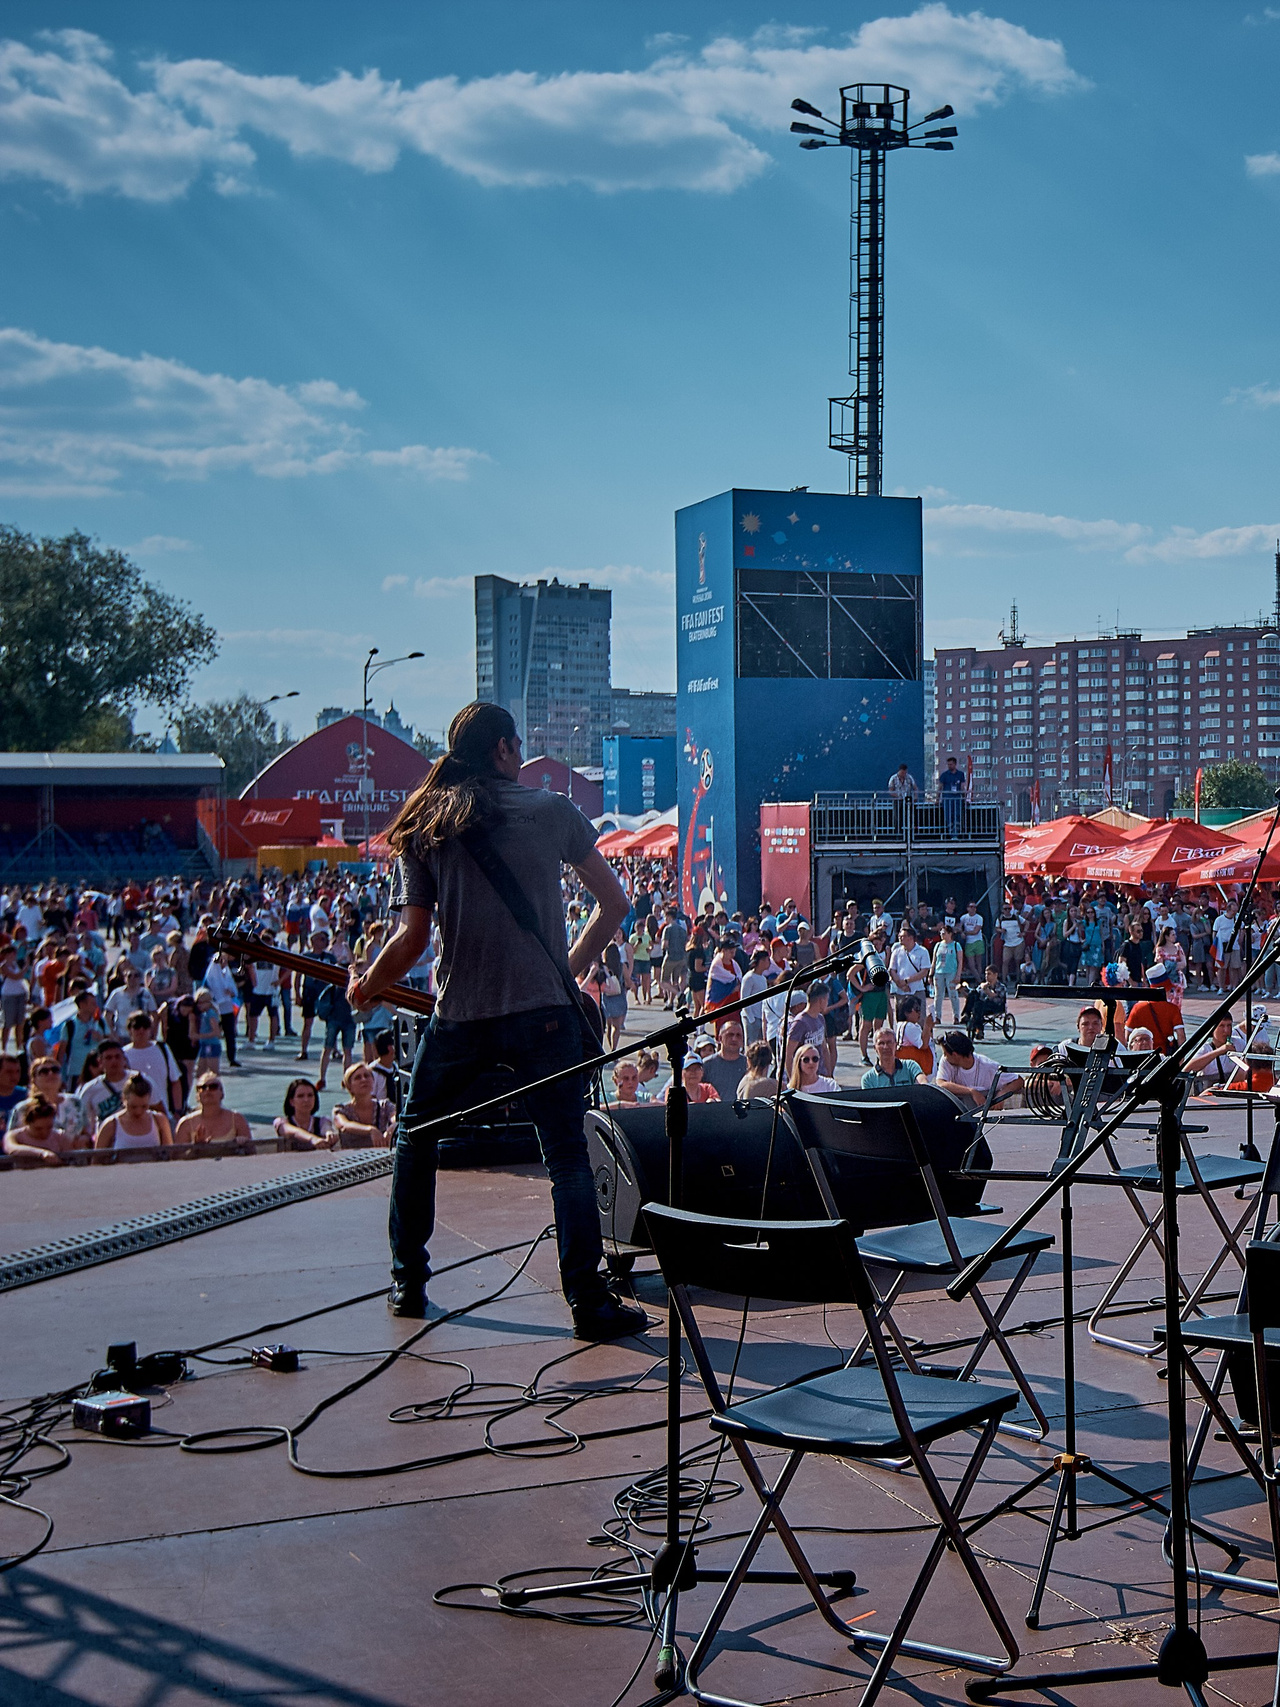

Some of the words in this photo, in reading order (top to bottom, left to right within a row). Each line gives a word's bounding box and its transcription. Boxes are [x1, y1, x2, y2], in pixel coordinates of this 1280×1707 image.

[681, 613, 695, 631] FIFA
[694, 610, 708, 628] FAN
[708, 605, 725, 625] FEST
[688, 626, 717, 643] EKATERINBURG
[370, 789, 408, 802] FEST
[342, 803, 390, 812] ERINBURG
[252, 811, 281, 823] Bud
[1178, 847, 1226, 859] Bud
